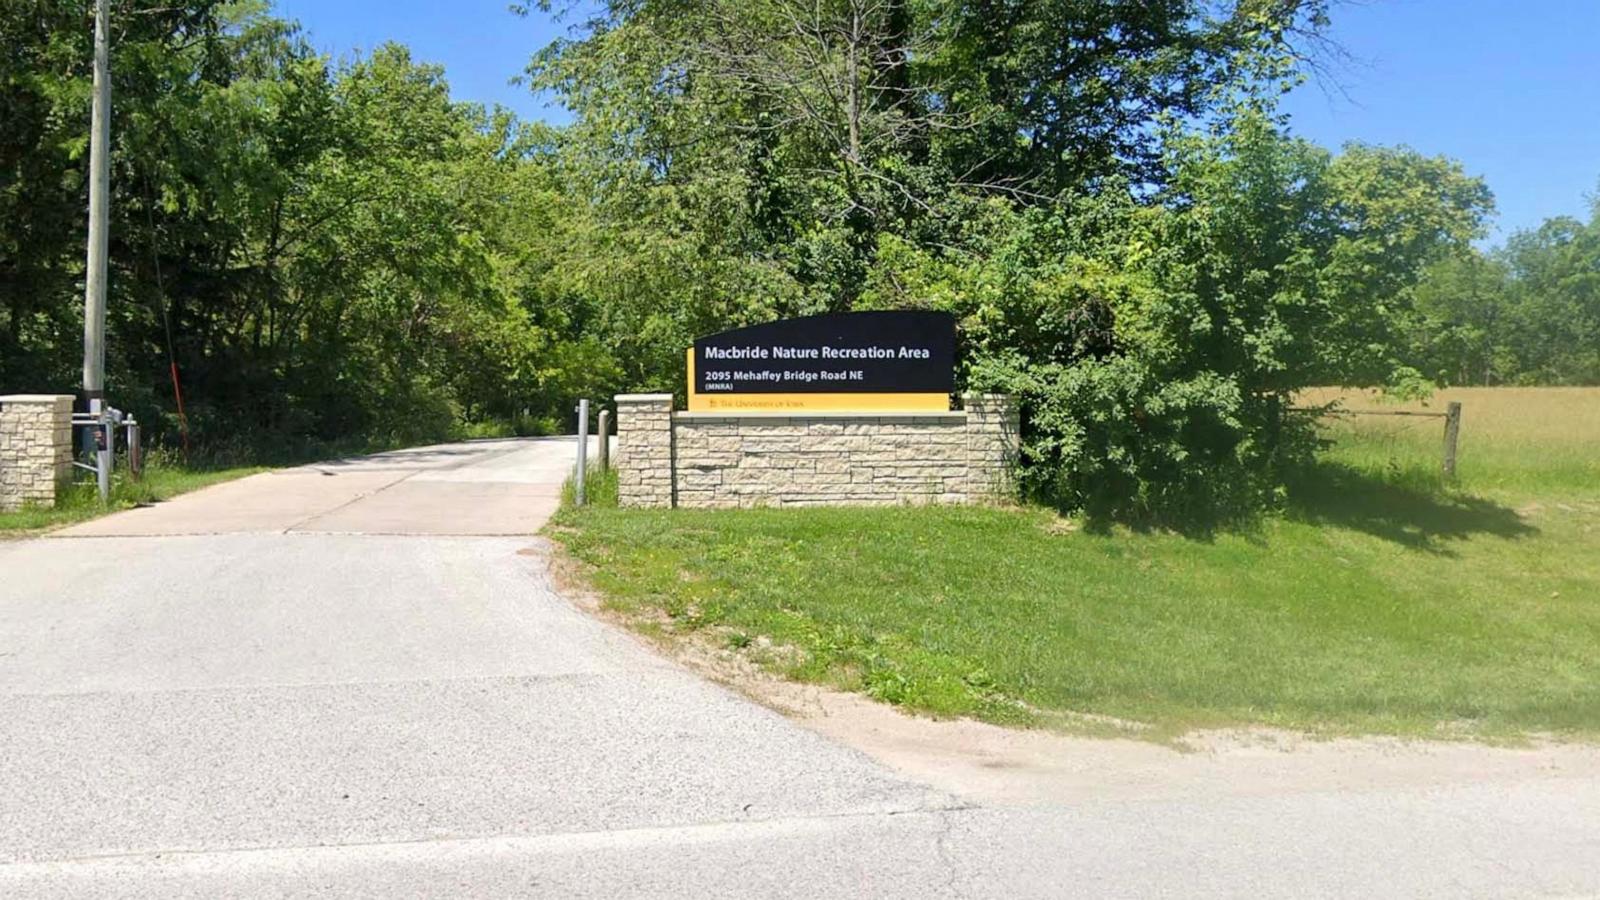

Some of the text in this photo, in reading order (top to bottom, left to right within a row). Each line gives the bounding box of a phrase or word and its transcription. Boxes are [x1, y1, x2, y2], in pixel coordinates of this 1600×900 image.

[705, 346, 930, 359] Macbride Nature Recreation Area
[705, 370, 863, 382] 2095 Mehaffey Bridge Road NE
[705, 383, 733, 391] (MNRA)
